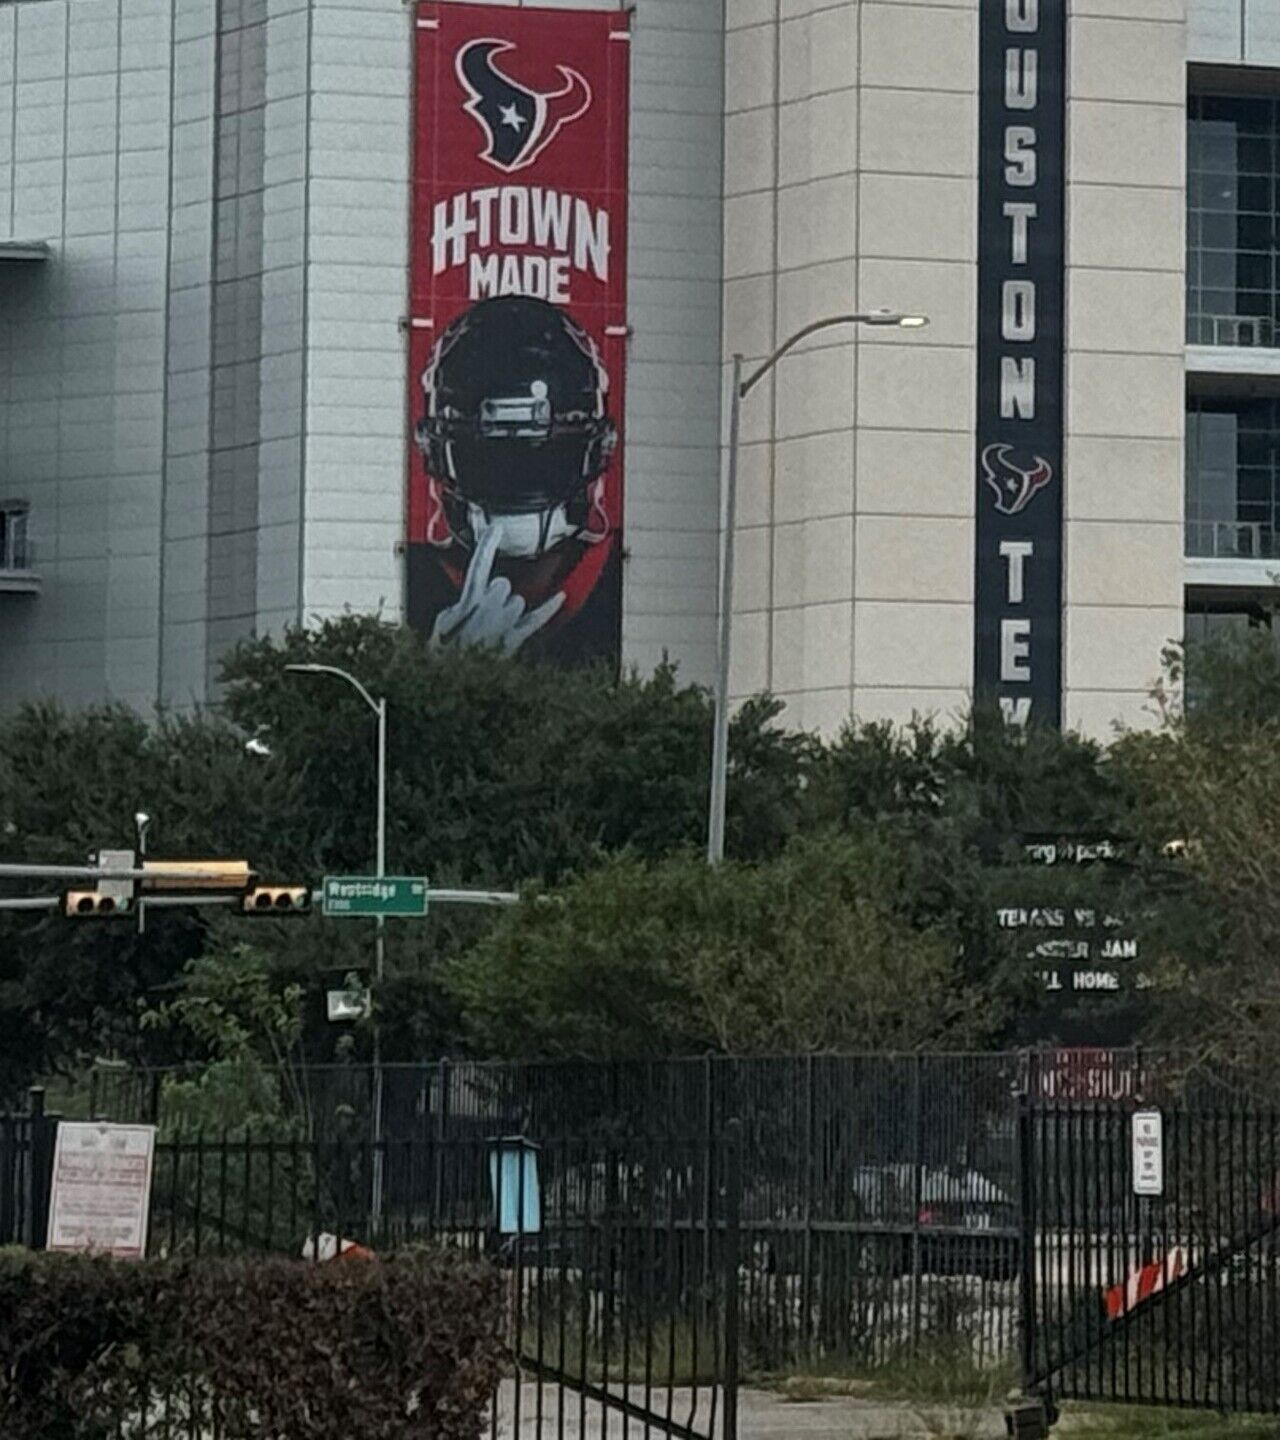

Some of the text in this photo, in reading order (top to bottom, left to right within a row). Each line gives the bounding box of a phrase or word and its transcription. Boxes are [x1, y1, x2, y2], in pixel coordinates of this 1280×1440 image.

[469, 253, 571, 303] MADE
[1101, 940, 1137, 958] JAM
[1073, 971, 1119, 989] HOME
